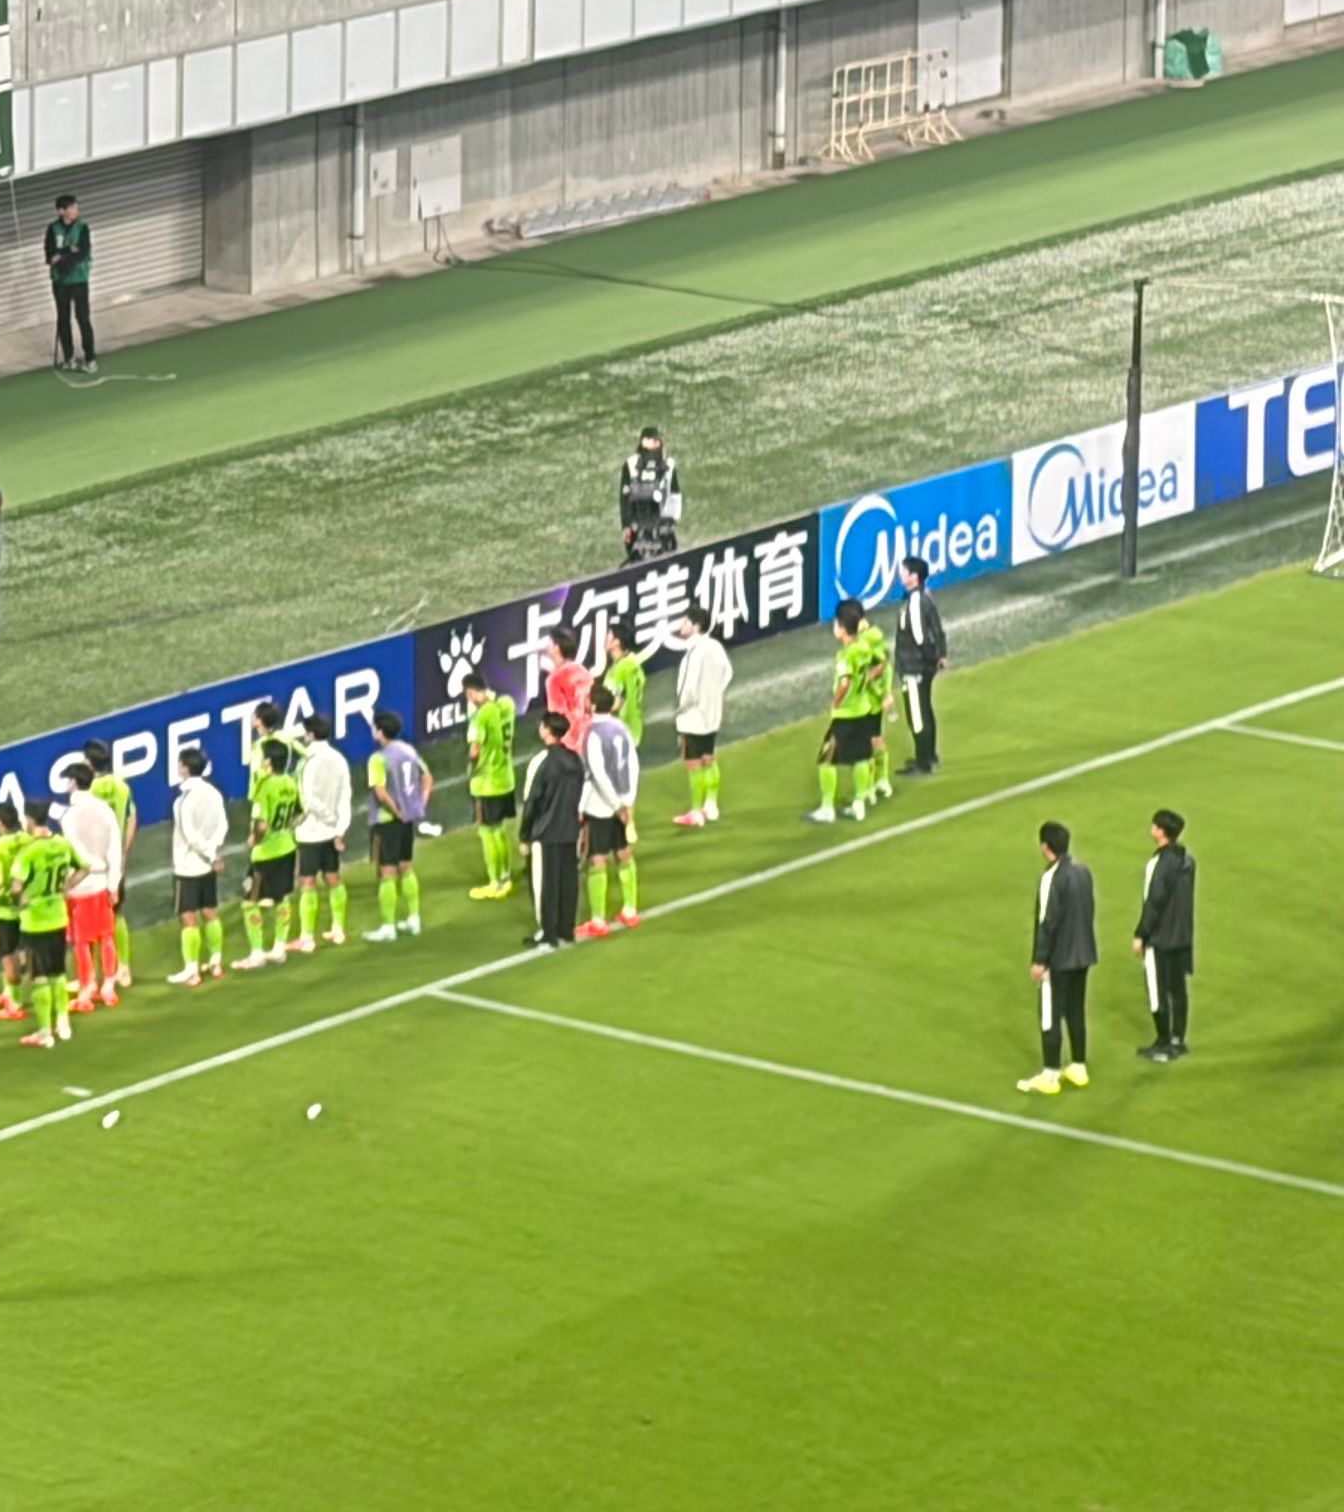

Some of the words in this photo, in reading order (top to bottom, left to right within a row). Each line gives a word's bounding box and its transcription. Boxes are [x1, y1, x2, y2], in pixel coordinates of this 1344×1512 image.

[1050, 459, 1179, 548] Midea
[857, 508, 1000, 609] Midea
[507, 528, 809, 699] 卡尔美体育
